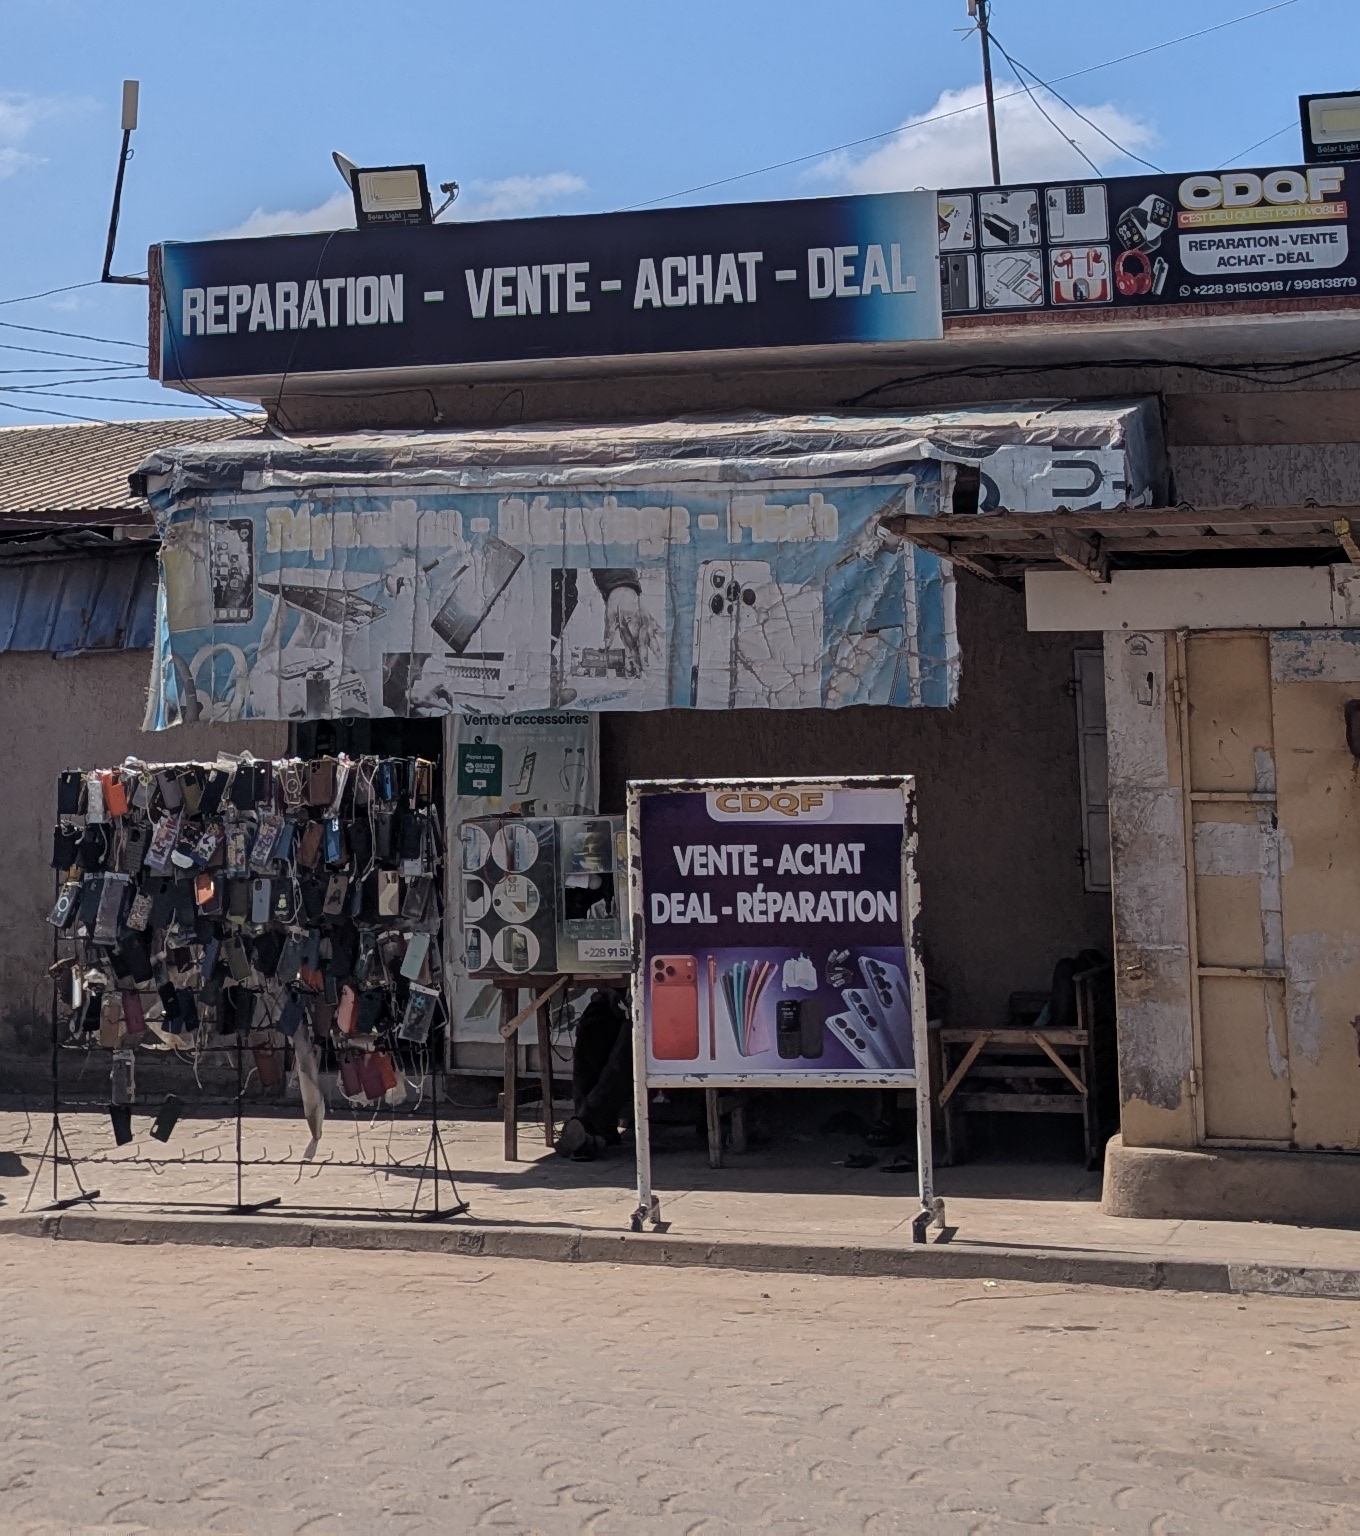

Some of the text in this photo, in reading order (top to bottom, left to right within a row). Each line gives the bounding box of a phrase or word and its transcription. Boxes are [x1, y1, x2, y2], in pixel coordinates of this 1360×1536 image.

[1339, 144, 1359, 152] Light
[1178, 167, 1346, 210] CDQF
[1210, 211, 1233, 221] DIEU
[1236, 210, 1251, 221] QUI
[1255, 209, 1273, 219] EST
[1304, 204, 1345, 215] MOBILE
[1189, 235, 1279, 252] REPARATION
[1289, 232, 1338, 246] VENTE
[1217, 254, 1265, 267] ACHAT
[1276, 252, 1314, 264] DEAL
[182, 273, 404, 337] REPARATION
[466, 261, 591, 319] VENTE
[634, 252, 763, 310] ACHAT
[808, 243, 917, 299] DEAL
[1193, 285, 1223, 295] +228
[1226, 282, 1283, 293] 91510918
[1294, 277, 1357, 289] 99813879
[463, 712, 589, 725] Vente d'accessoires
[715, 792, 824, 816] CDQF
[673, 844, 758, 876] VENTE
[777, 843, 865, 875] ACHAT
[651, 892, 718, 924] DEAL
[736, 883, 897, 923] RÉPARATION
[584, 948, 628, 958] +228 91 51
